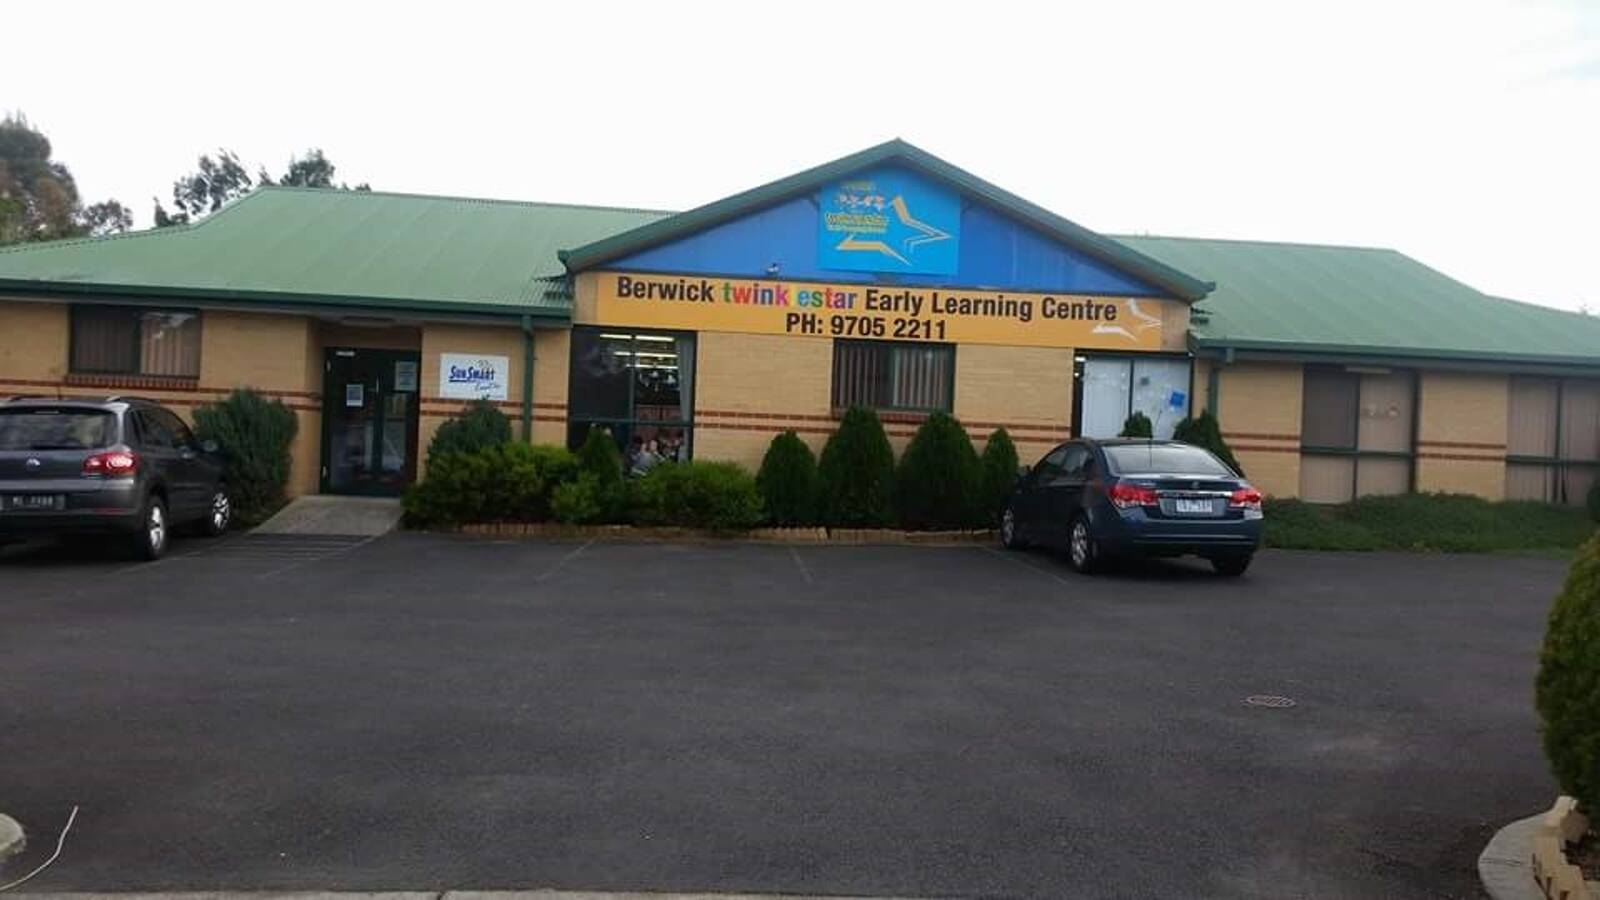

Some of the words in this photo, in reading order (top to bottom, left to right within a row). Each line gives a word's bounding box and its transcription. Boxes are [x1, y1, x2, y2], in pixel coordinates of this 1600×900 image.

[617, 277, 714, 303] Berwick
[722, 281, 858, 309] twinkestar
[866, 289, 923, 316] Early
[931, 292, 1033, 321] Learning
[1041, 297, 1117, 321] Centre
[786, 312, 823, 334] PH:
[831, 315, 886, 337] 9705
[893, 318, 946, 339] 2211
